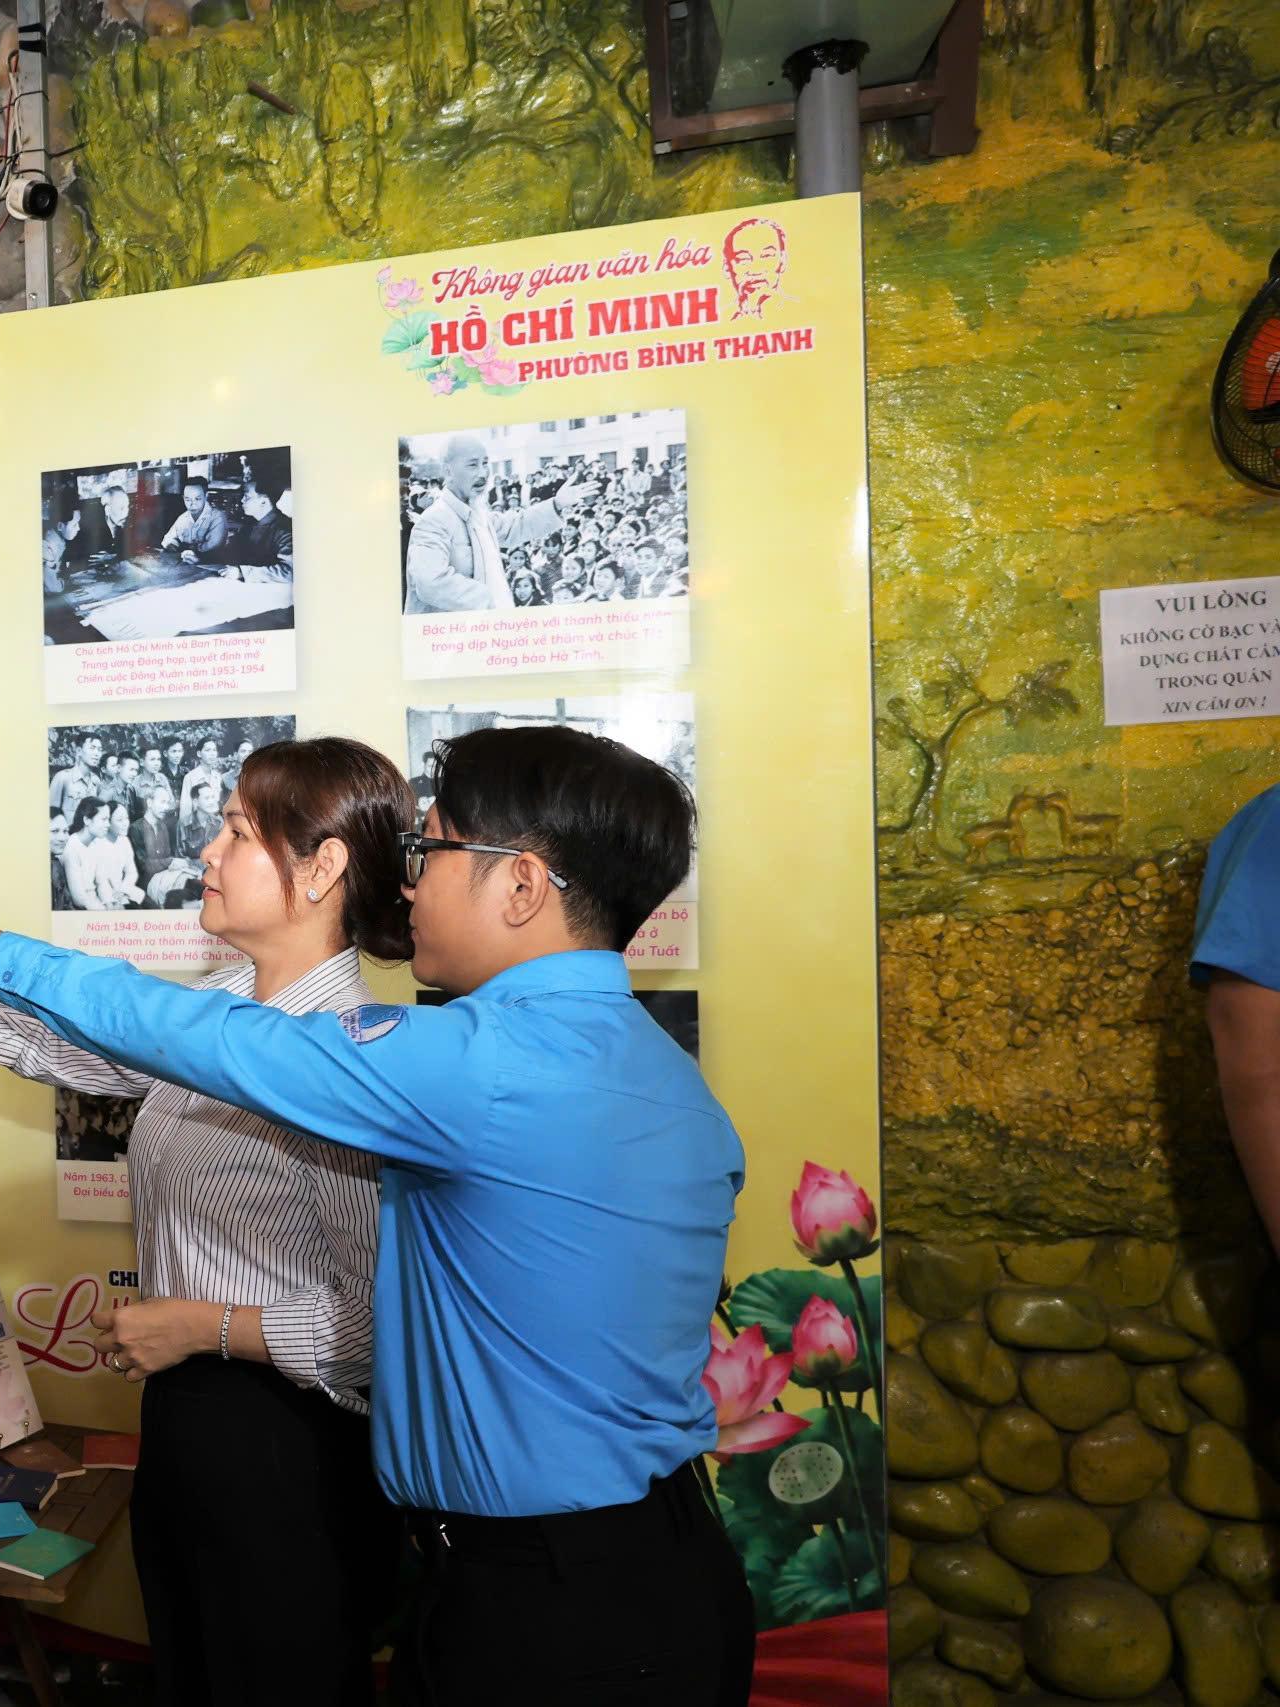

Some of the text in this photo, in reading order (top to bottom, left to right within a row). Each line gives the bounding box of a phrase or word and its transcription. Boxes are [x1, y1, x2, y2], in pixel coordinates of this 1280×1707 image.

[432, 238, 713, 304] Không gian văn hóa
[431, 287, 718, 356] HỒ CHÍ MINH
[518, 329, 813, 382] PHƯỜNG BÌNH THẠNH
[1155, 589, 1267, 613] VUI LÒNG
[565, 613, 601, 625] thanh
[1120, 628, 1184, 645] KHÔNG
[1189, 624, 1215, 640] CỜ
[1220, 623, 1254, 639] BẠC
[151, 641, 173, 651] Minh
[191, 639, 209, 648] Ban
[431, 642, 464, 653] trong
[1139, 652, 1189, 669] DỤNG
[1194, 645, 1242, 663] CHẤT
[82, 661, 108, 670] Trung
[212, 664, 265, 676] 1953-1954
[1155, 668, 1272, 689] TRONG QUÁN
[1162, 701, 1193, 714] XIN
[1195, 696, 1231, 711] CẢM
[1234, 697, 1257, 709] ƠN
[671, 909, 689, 922] bộ
[86, 922, 109, 931] Năm
[114, 922, 140, 932] 1949,
[144, 921, 171, 931] Đoàn
[174, 921, 190, 932] đại
[91, 936, 115, 946] miền
[118, 938, 142, 946] Nam
[159, 937, 185, 946] thăm
[188, 935, 213, 946] miền
[162, 952, 180, 960] bên
[201, 950, 222, 960] Chủ
[225, 951, 244, 963] tịch
[649, 943, 680, 957] Tuất
[64, 1171, 87, 1181] Năm
[73, 1186, 114, 1197] Đại biểu
